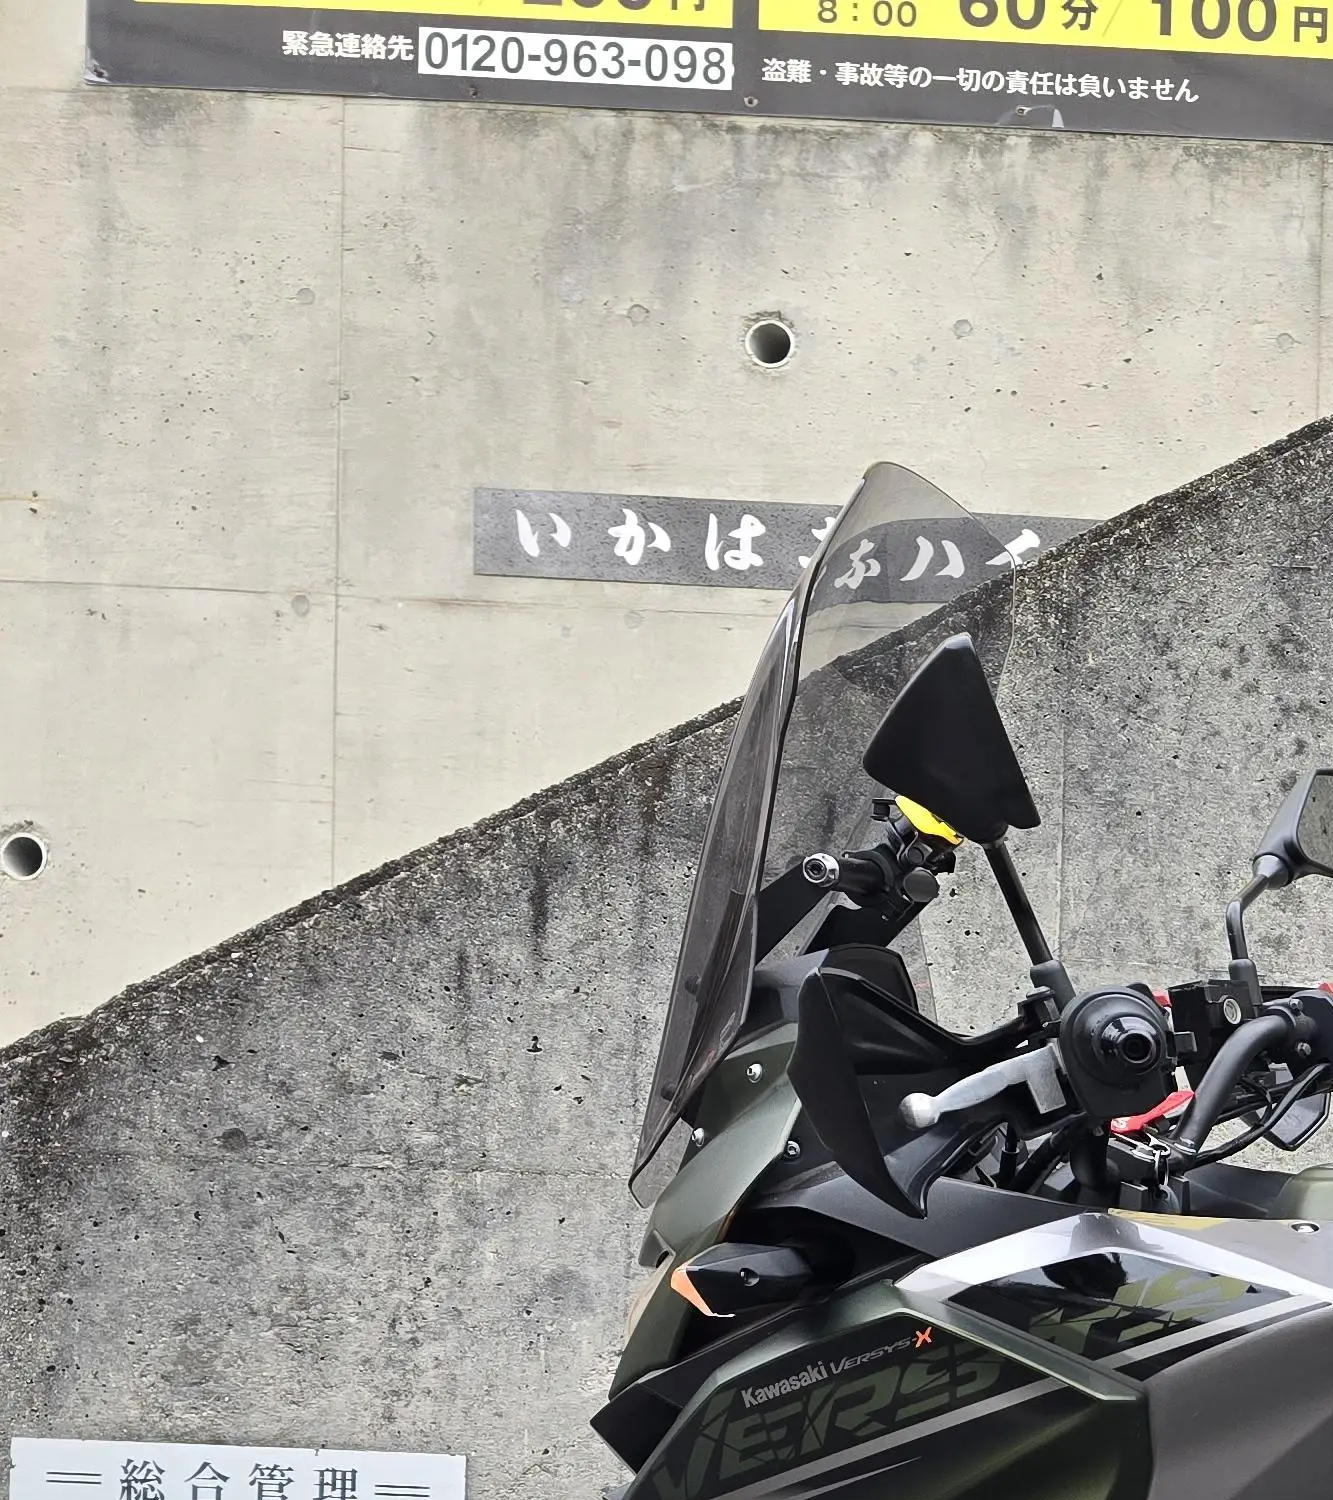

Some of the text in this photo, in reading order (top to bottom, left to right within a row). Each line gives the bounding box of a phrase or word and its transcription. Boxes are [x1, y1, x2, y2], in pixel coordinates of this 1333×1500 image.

[282, 30, 415, 61] 緊急連絡先
[424, 31, 727, 85] 0120-963-098
[761, 58, 1200, 103] 盗難・事故等の一切の責任は負いません
[740, 1360, 829, 1408] Kawasaki
